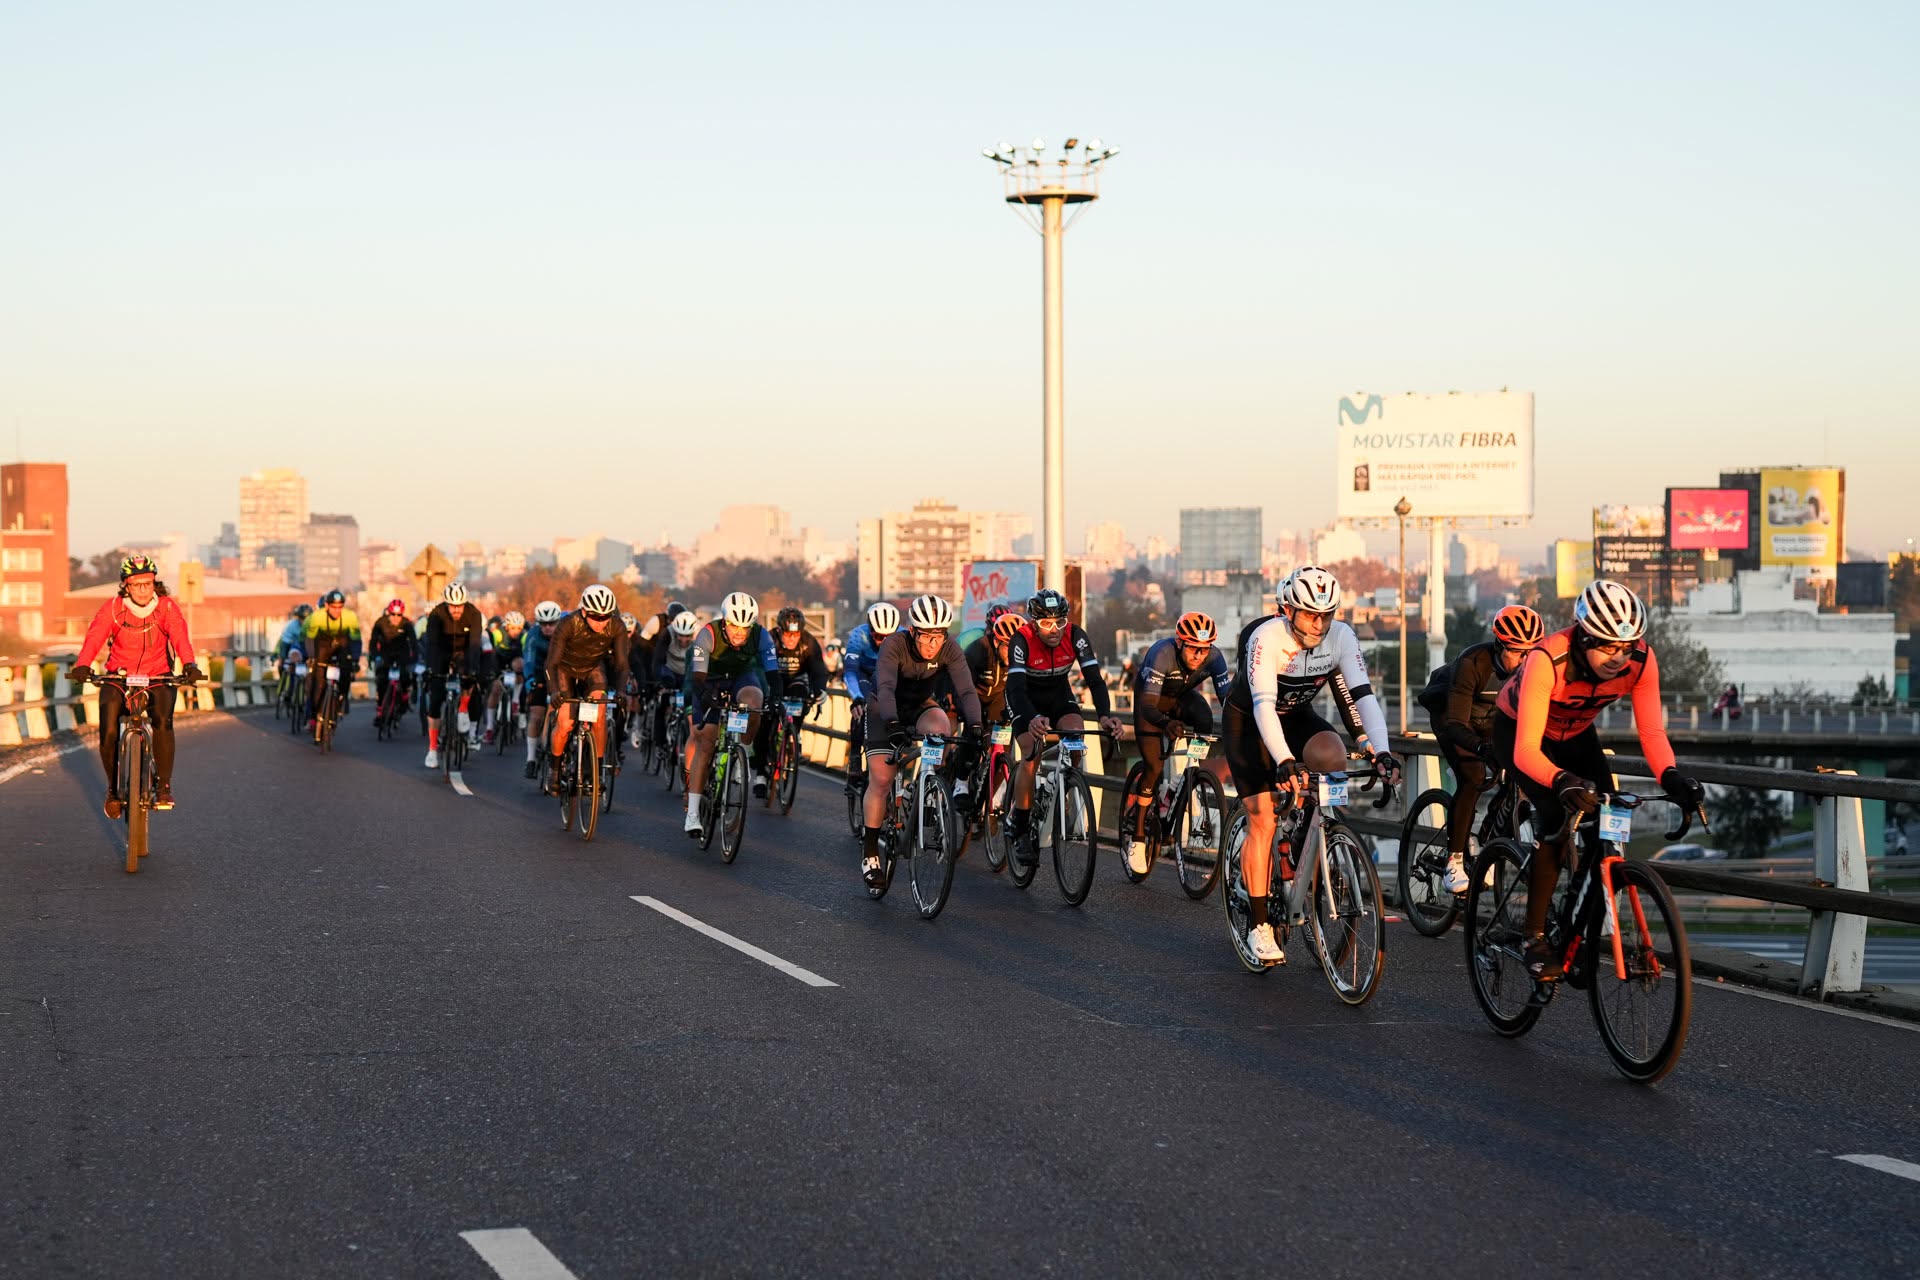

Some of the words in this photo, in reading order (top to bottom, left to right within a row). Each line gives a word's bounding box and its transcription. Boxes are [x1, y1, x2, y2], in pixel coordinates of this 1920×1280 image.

[1353, 433, 1455, 449] MOVISTAR
[1459, 432, 1517, 448] FIBRA
[1602, 561, 1630, 573] Prex
[1255, 645, 1263, 665] BIKE
[1335, 673, 1354, 704] ITALIANA
[1348, 702, 1363, 727] GRUPO
[924, 748, 940, 757] 206
[1609, 818, 1623, 828] 67
